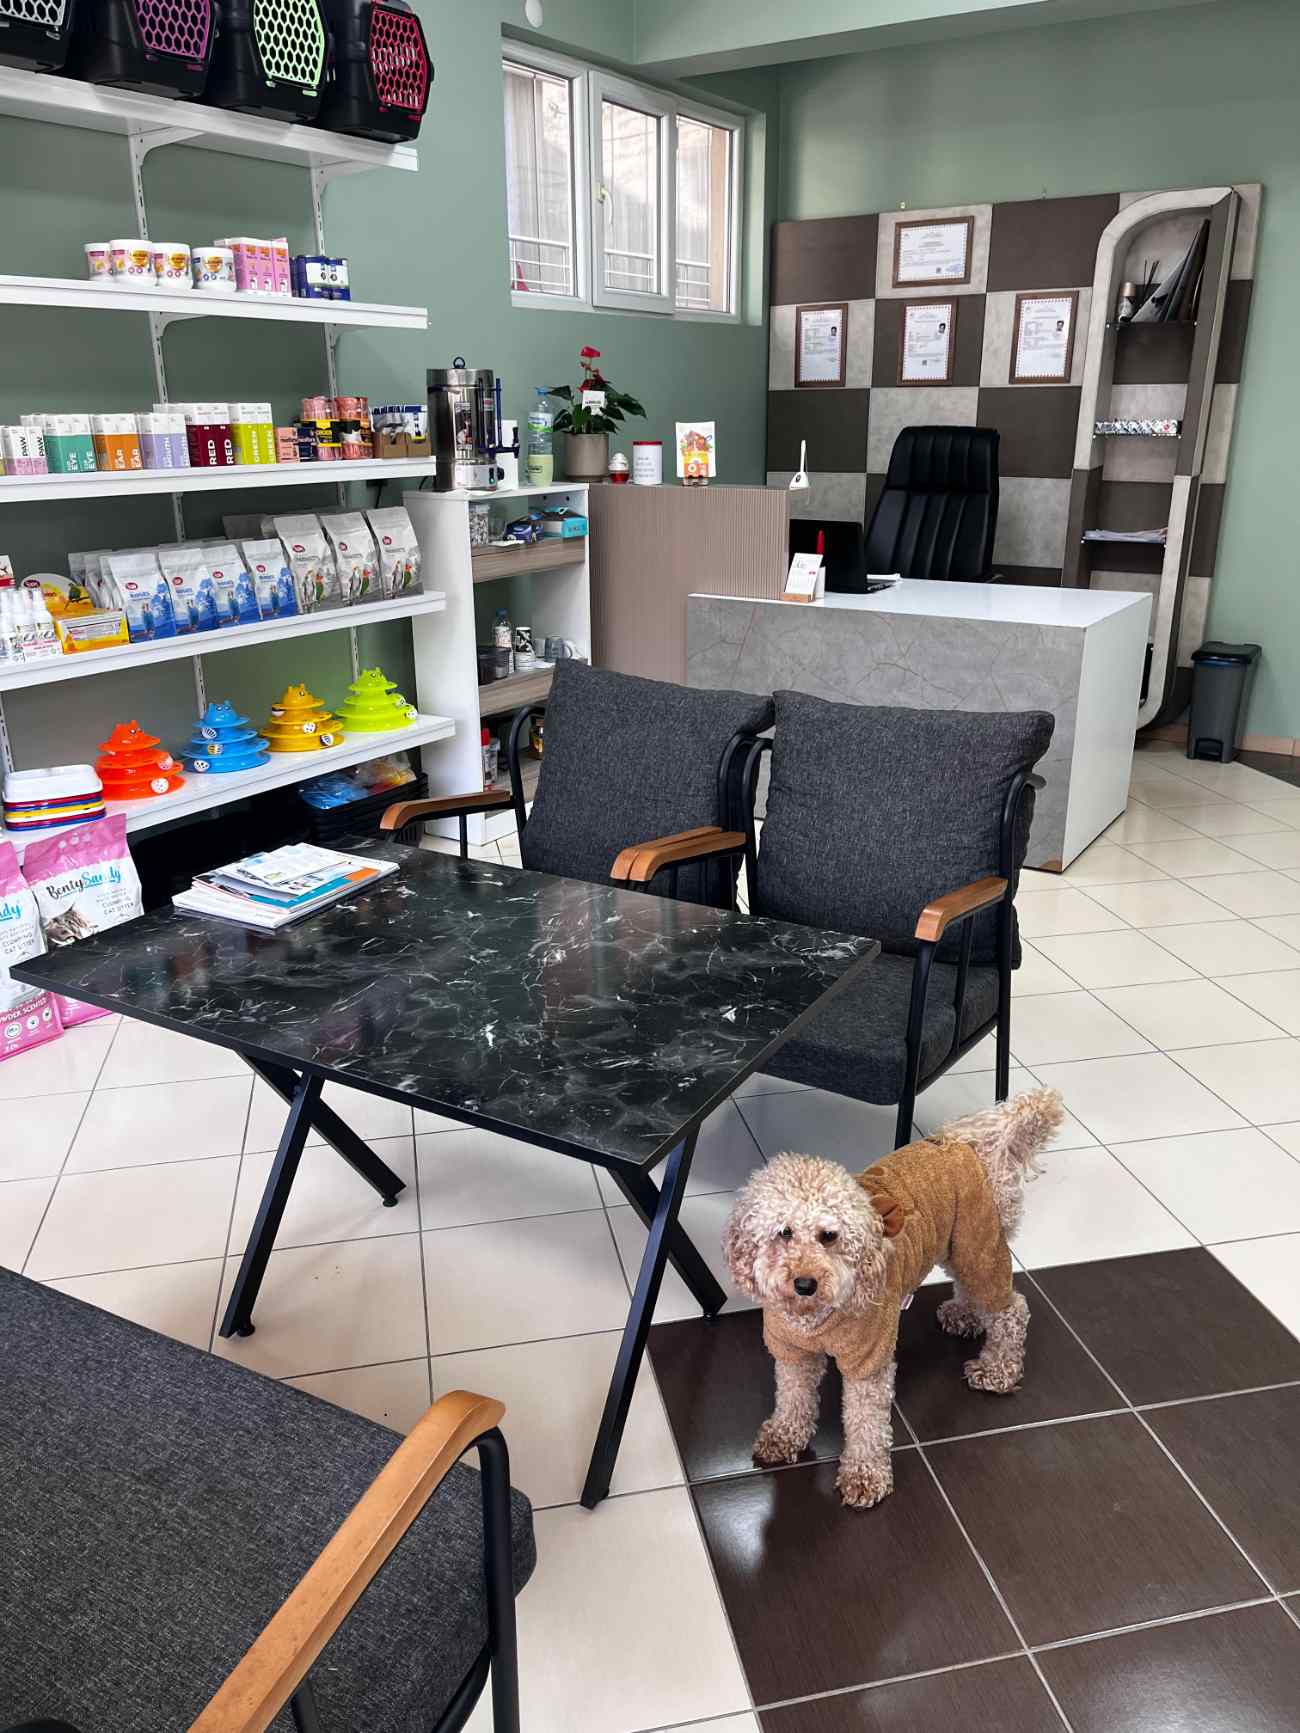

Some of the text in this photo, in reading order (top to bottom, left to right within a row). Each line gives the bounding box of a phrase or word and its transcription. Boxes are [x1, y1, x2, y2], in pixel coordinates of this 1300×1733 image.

[19, 436, 28, 457] PAW
[37, 436, 45, 457] PAW
[208, 440, 217, 465] RED
[224, 439, 234, 464] RED
[87, 451, 95, 469] EYE
